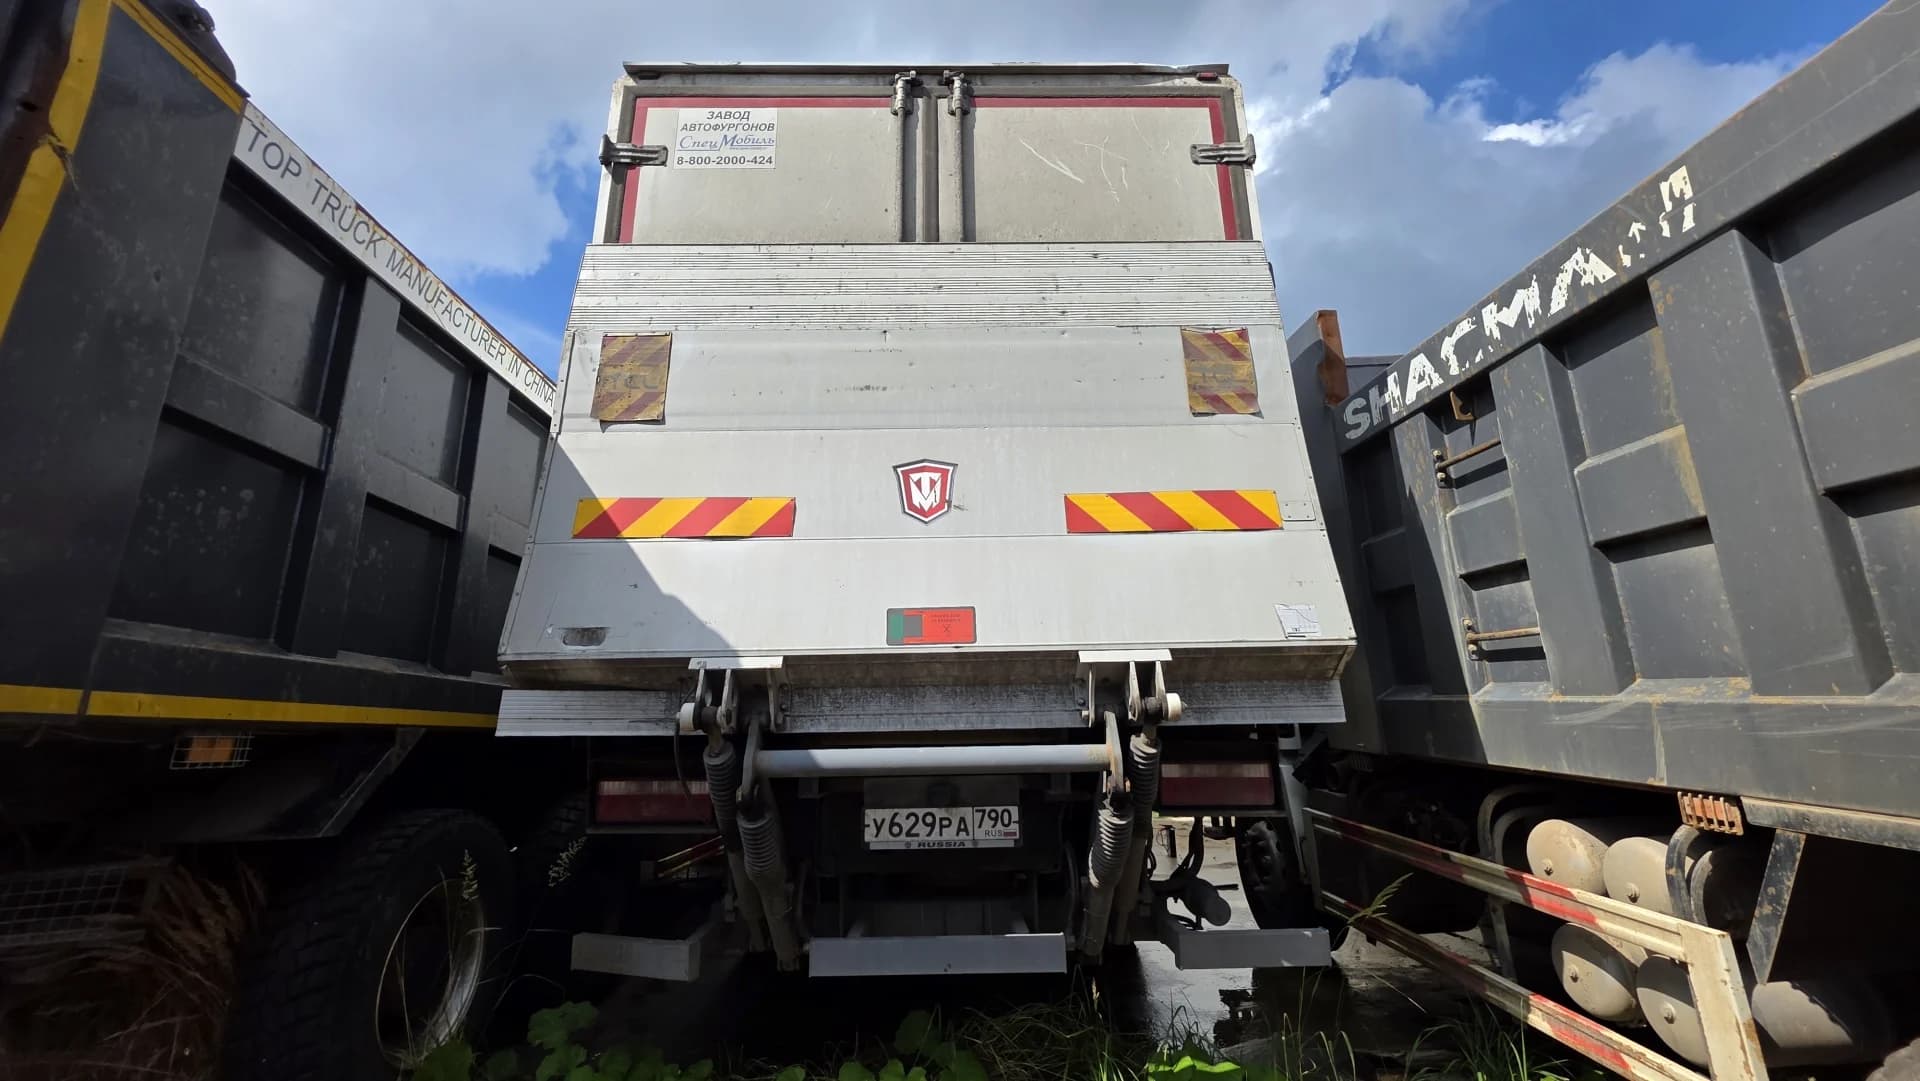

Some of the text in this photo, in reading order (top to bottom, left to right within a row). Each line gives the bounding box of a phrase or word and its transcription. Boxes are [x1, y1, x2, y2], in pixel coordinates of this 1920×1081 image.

[706, 111, 751, 121] ЗАВОД
[680, 122, 775, 132] АВТОФУРГОНОВ
[676, 155, 773, 165] 8-800-2000-424
[247, 123, 555, 408] TOP TRUCK MANUFACTURER IN CHINA
[975, 808, 1012, 829] 790
[984, 829, 1003, 837] RUS
[917, 840, 966, 848] RUSSIA
